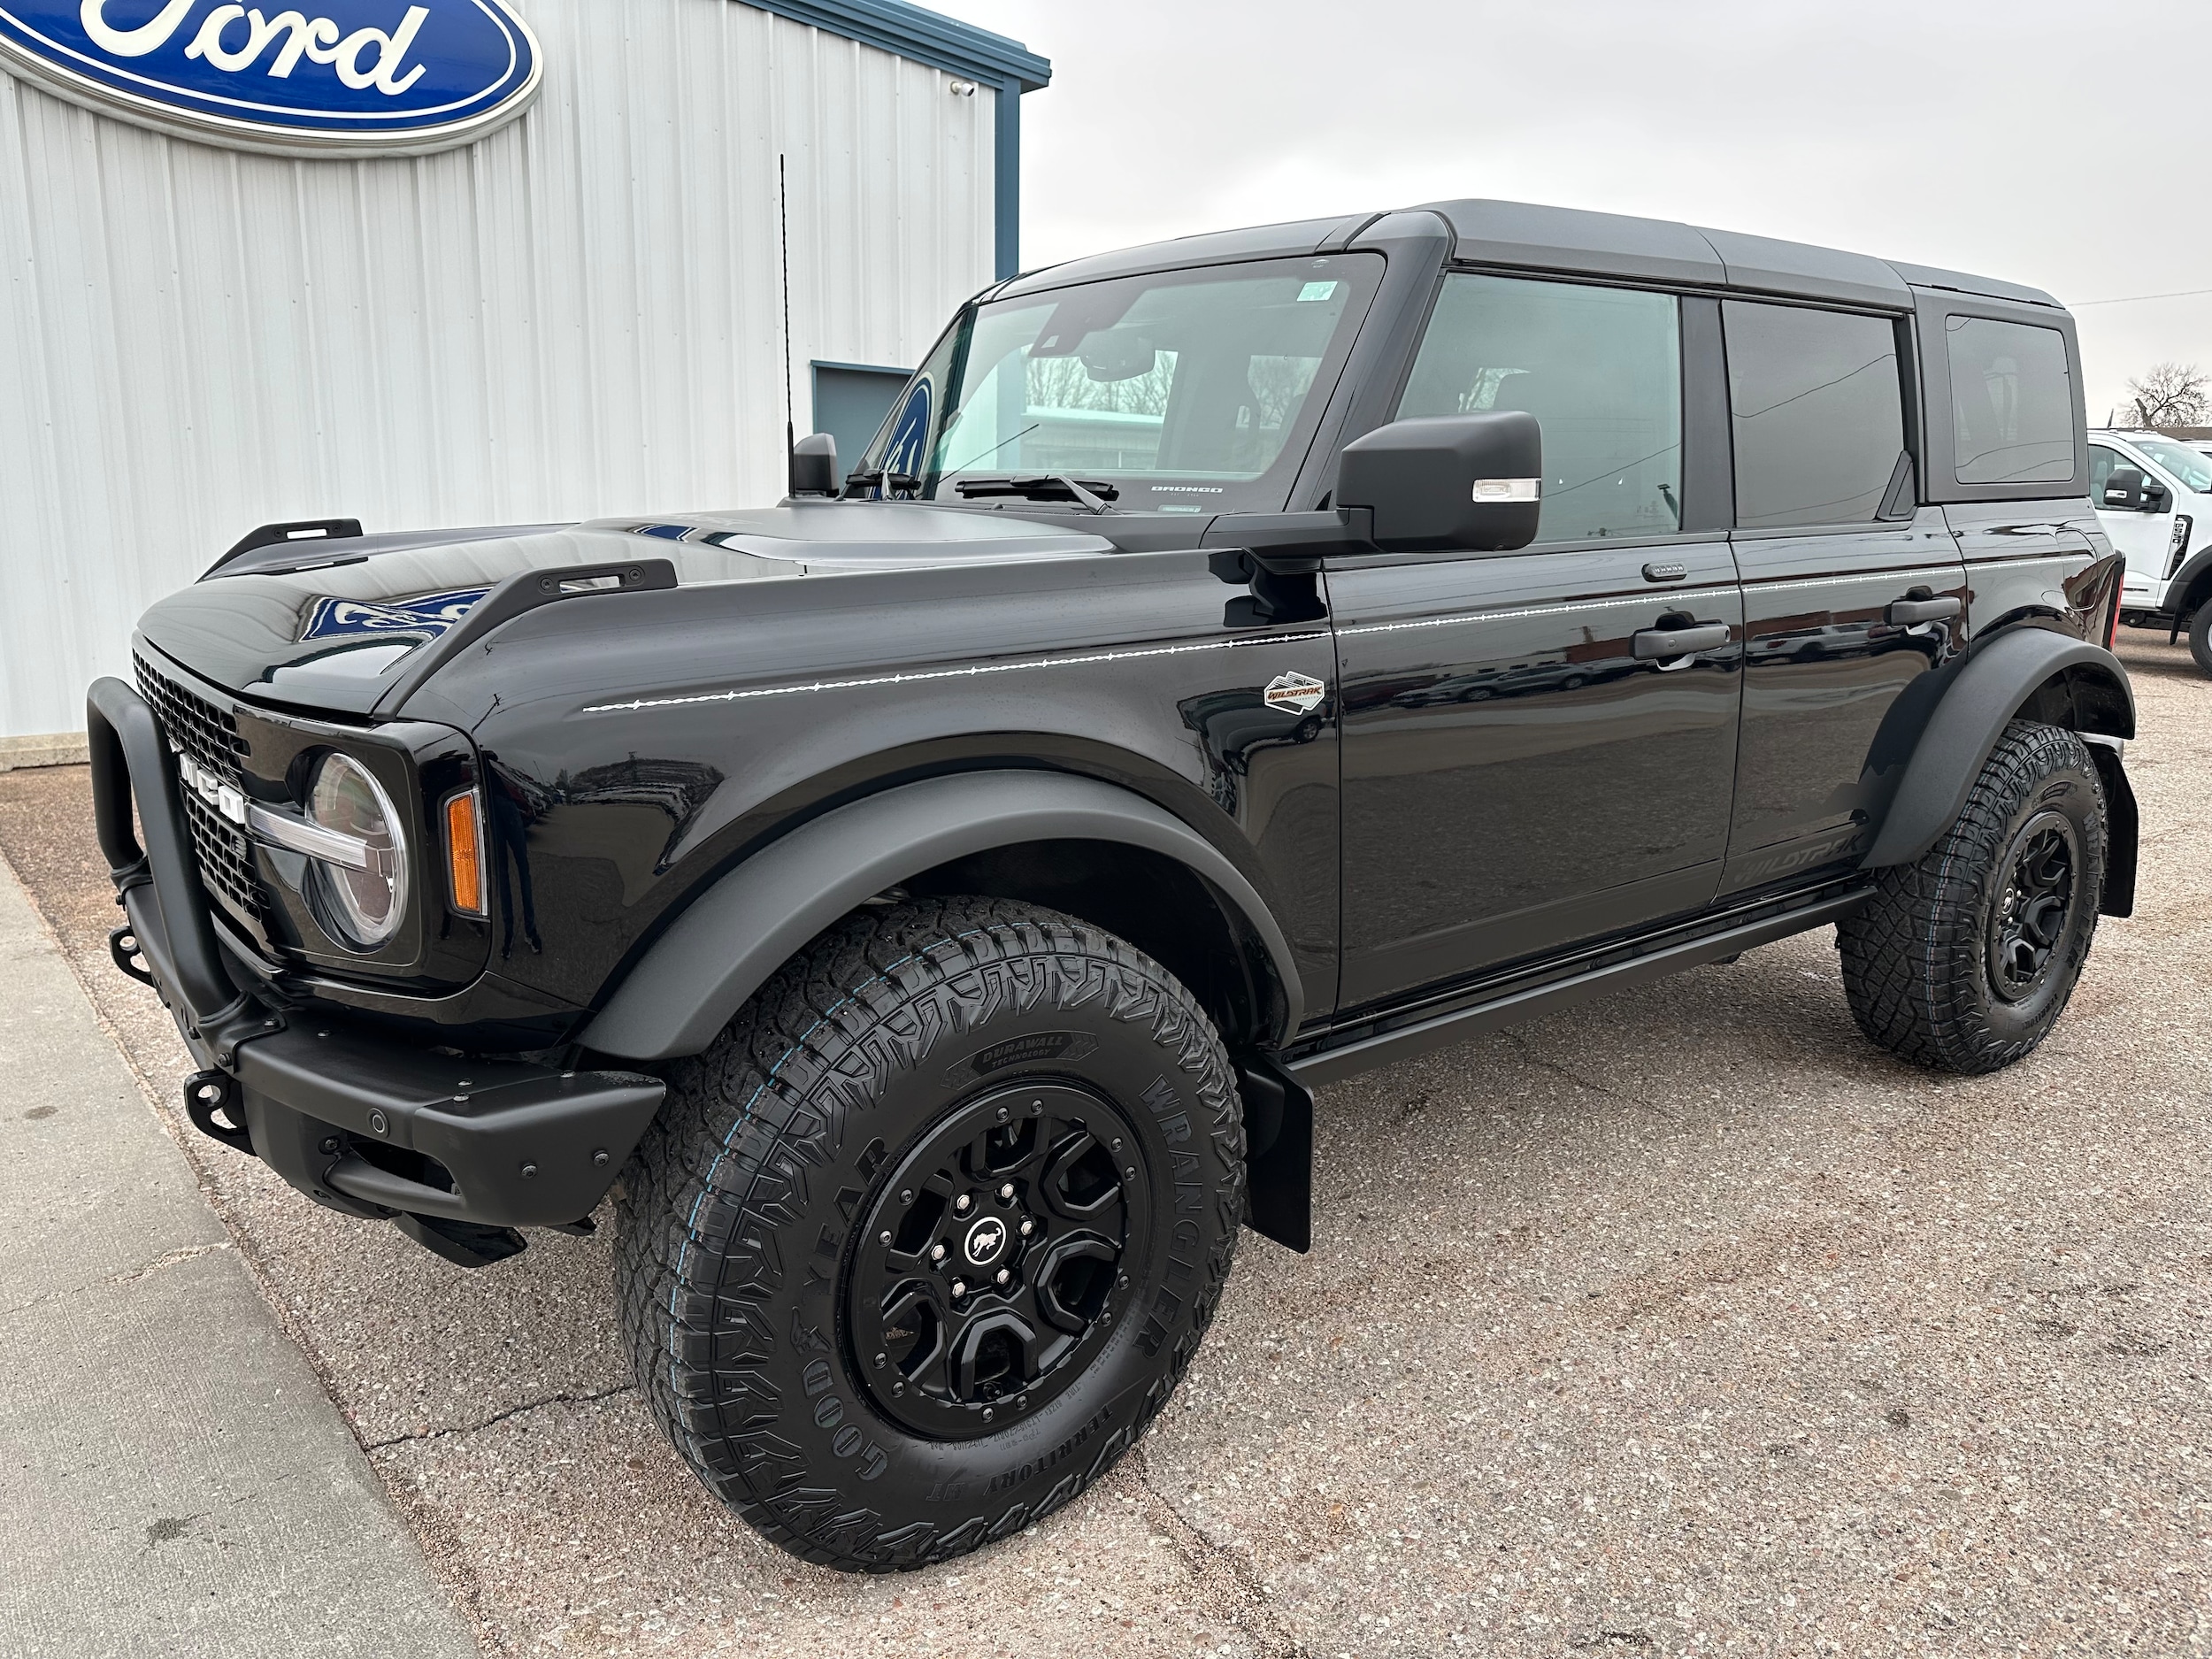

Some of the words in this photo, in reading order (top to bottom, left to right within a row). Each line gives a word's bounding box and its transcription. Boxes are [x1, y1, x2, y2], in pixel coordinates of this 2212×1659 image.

[1267, 686, 1323, 701] WILDTRAK
[169, 738, 246, 825] NCO
[1734, 833, 1864, 883] WILDTRAK
[982, 1036, 1064, 1064] DURAWALL
[992, 1048, 1051, 1069] TECHNOLOGY
[1132, 1073, 1203, 1358] WRANGLER
[983, 1403, 1113, 1497] TERRITORY
